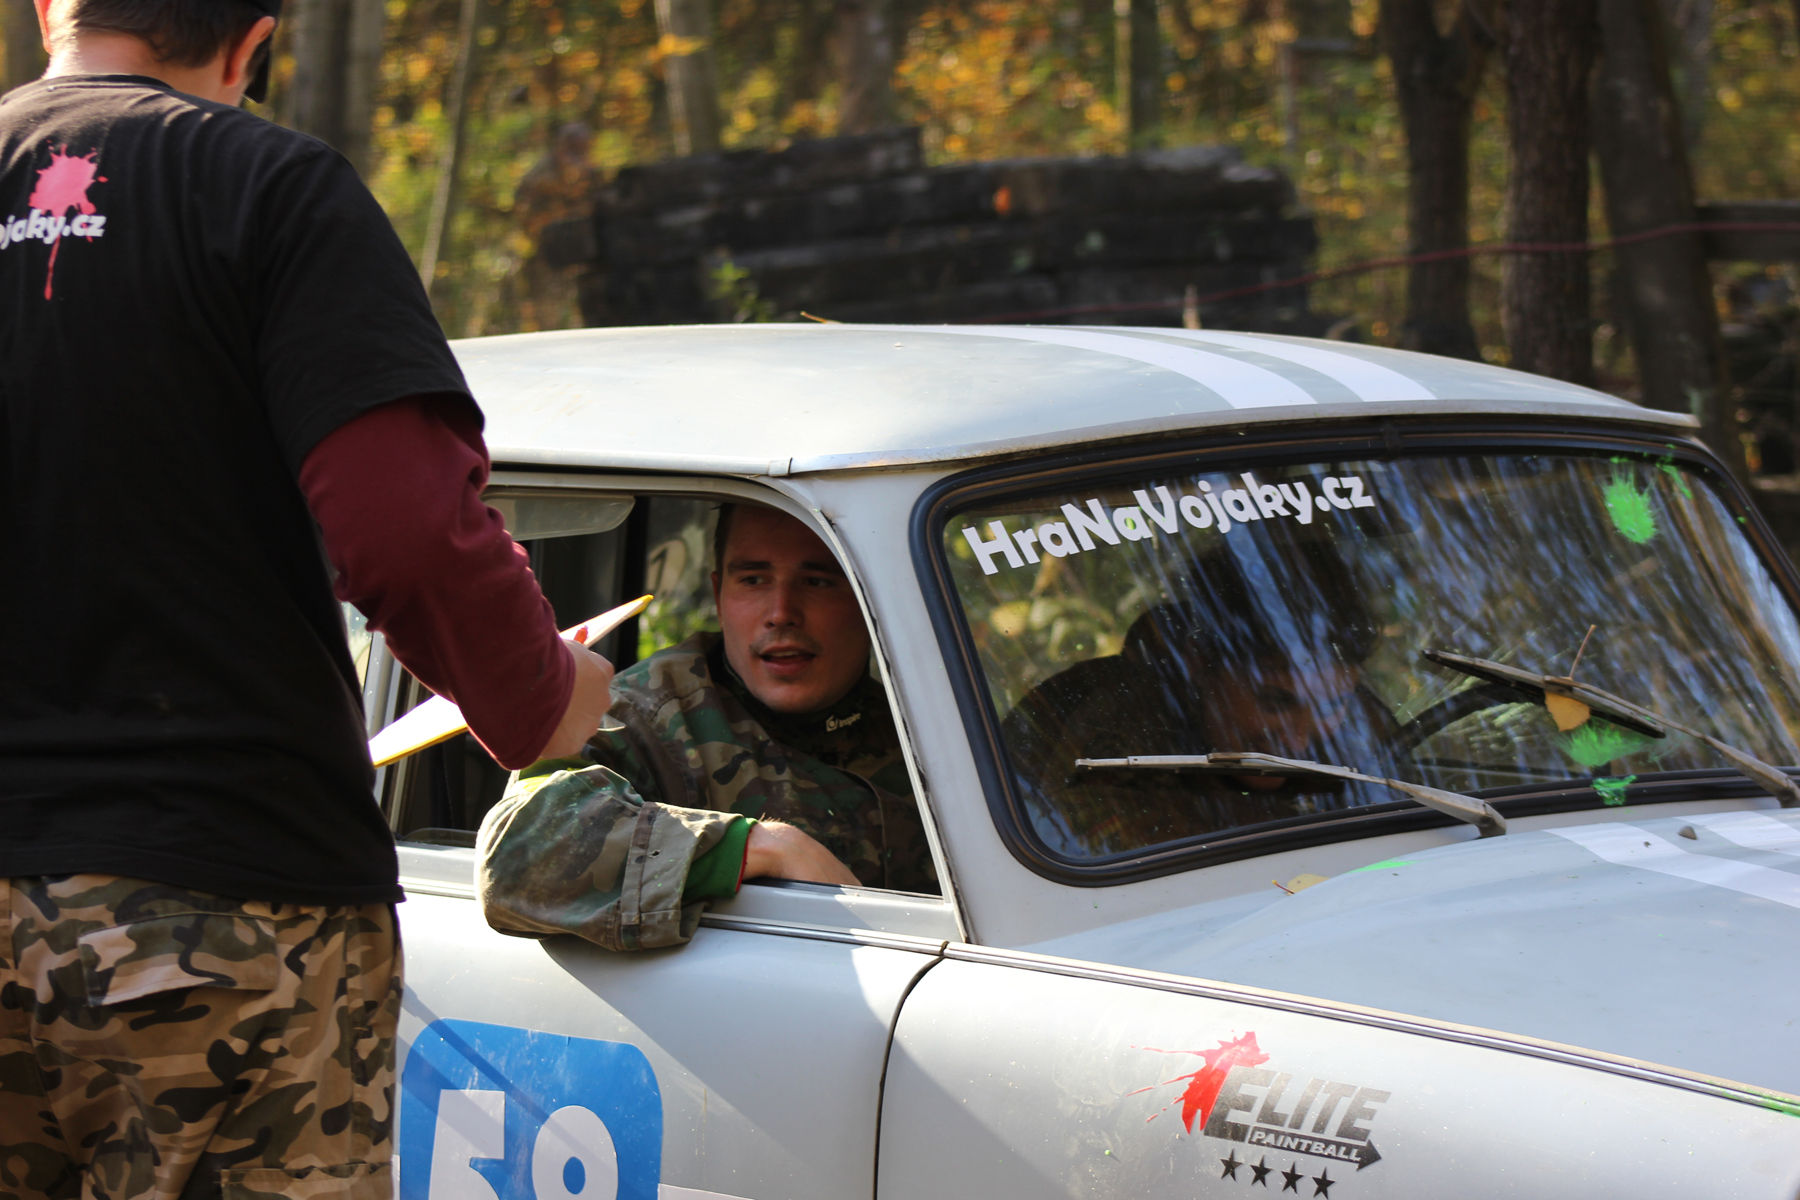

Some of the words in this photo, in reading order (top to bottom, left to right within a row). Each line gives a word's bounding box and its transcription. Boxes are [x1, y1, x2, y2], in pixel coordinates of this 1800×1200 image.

[961, 472, 1375, 576] HraNaVojaky.cz
[1203, 1064, 1392, 1143] ELITE
[1251, 1130, 1361, 1162] PAINTBALL
